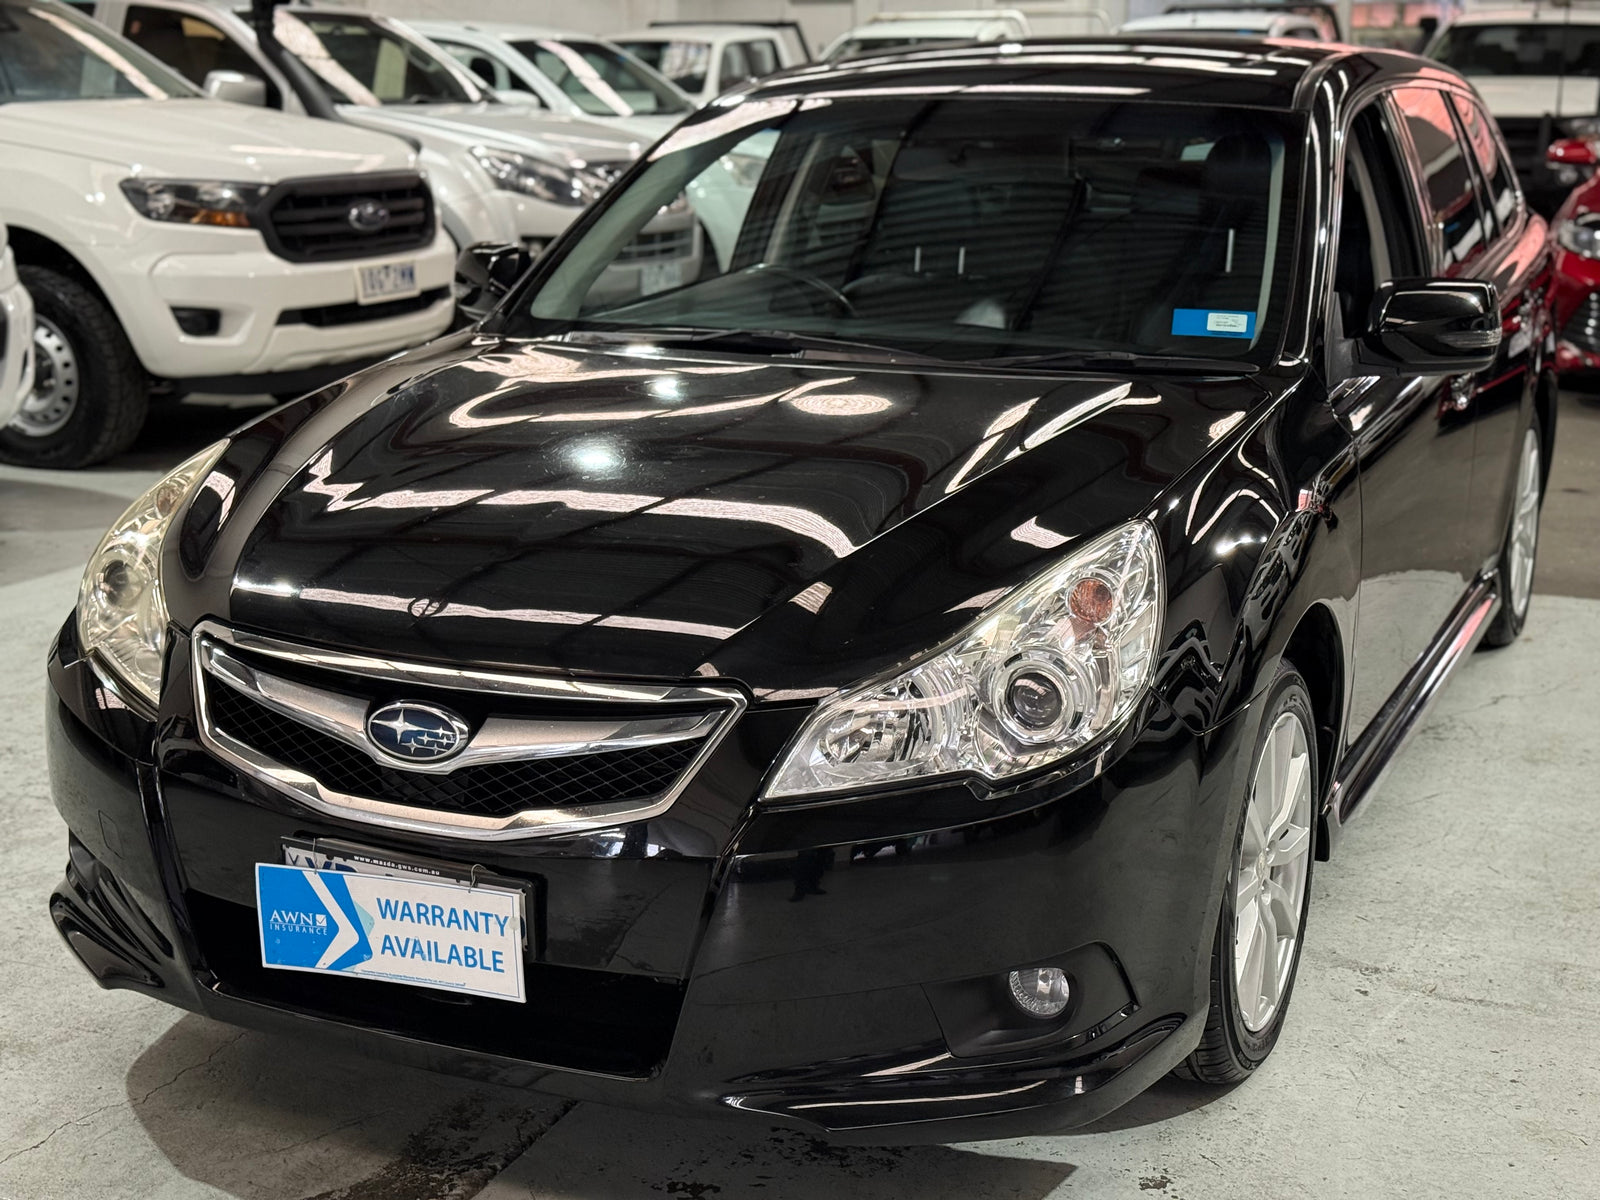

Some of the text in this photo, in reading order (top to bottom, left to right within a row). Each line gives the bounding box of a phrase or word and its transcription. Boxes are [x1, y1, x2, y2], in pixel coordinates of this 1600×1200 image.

[269, 909, 313, 926] AWN
[269, 923, 328, 936] INSURANCE
[376, 897, 510, 937] WARRANTY
[380, 934, 505, 973] AVAILABLE
